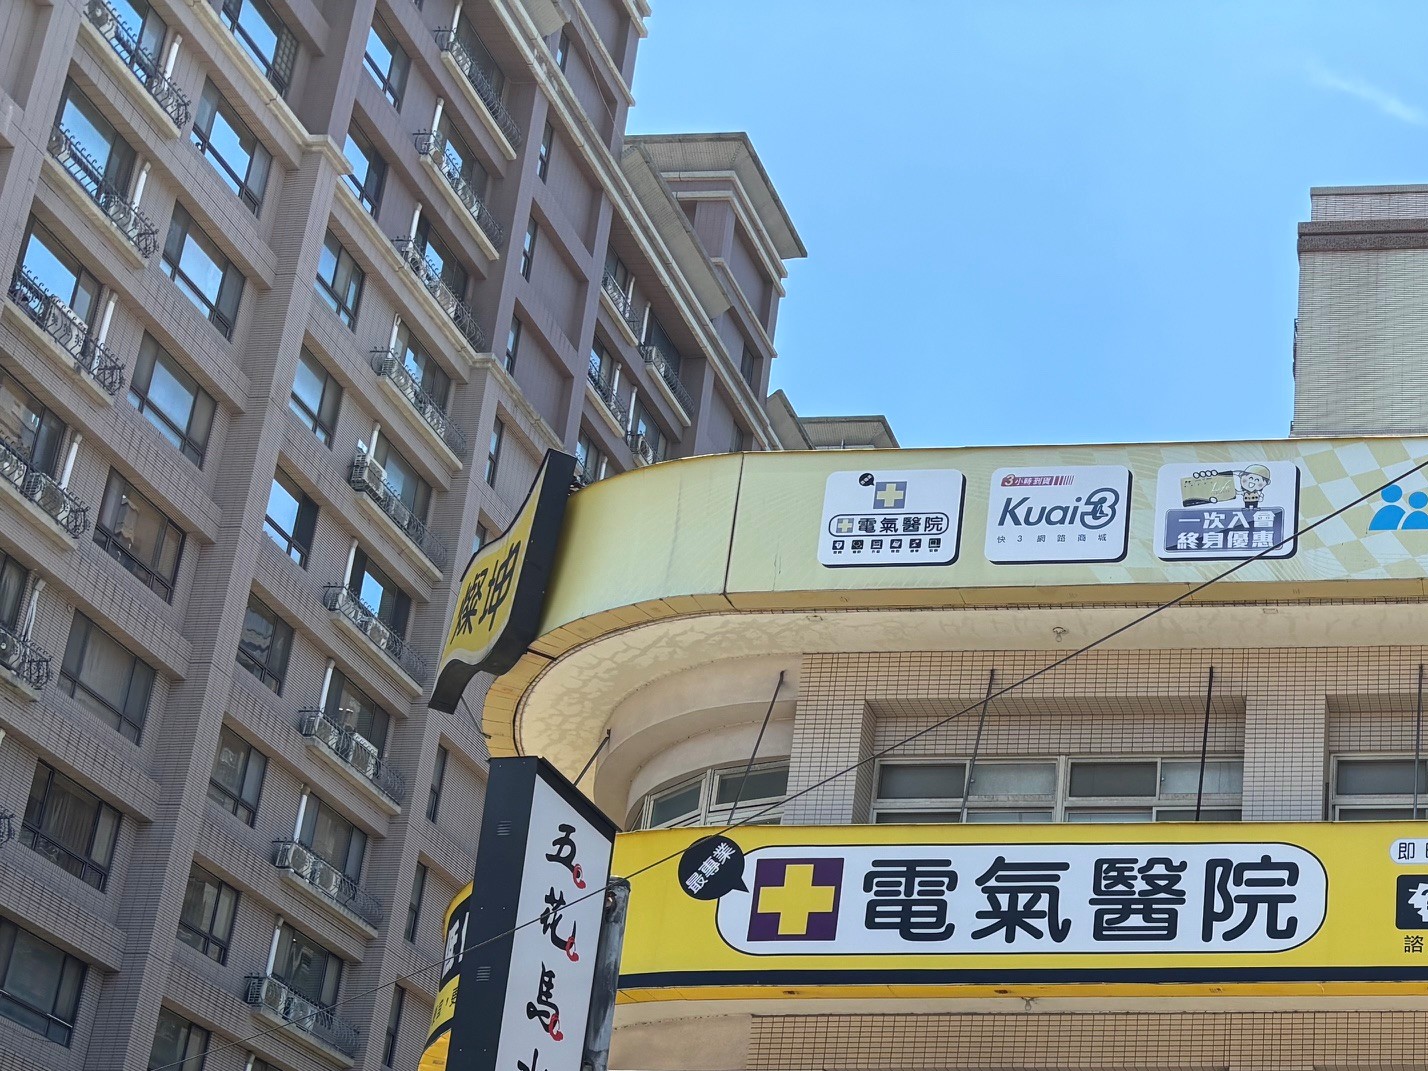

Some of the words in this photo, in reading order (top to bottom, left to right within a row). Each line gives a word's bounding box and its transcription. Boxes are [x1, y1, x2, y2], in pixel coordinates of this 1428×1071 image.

[858, 516, 944, 534] 電氣醫院
[1178, 511, 1277, 529] 一次入會
[1177, 531, 1275, 550] 終身優惠
[450, 540, 521, 645] 燦坤
[687, 841, 738, 895] 最專業
[863, 855, 1300, 944] 電氣醫院
